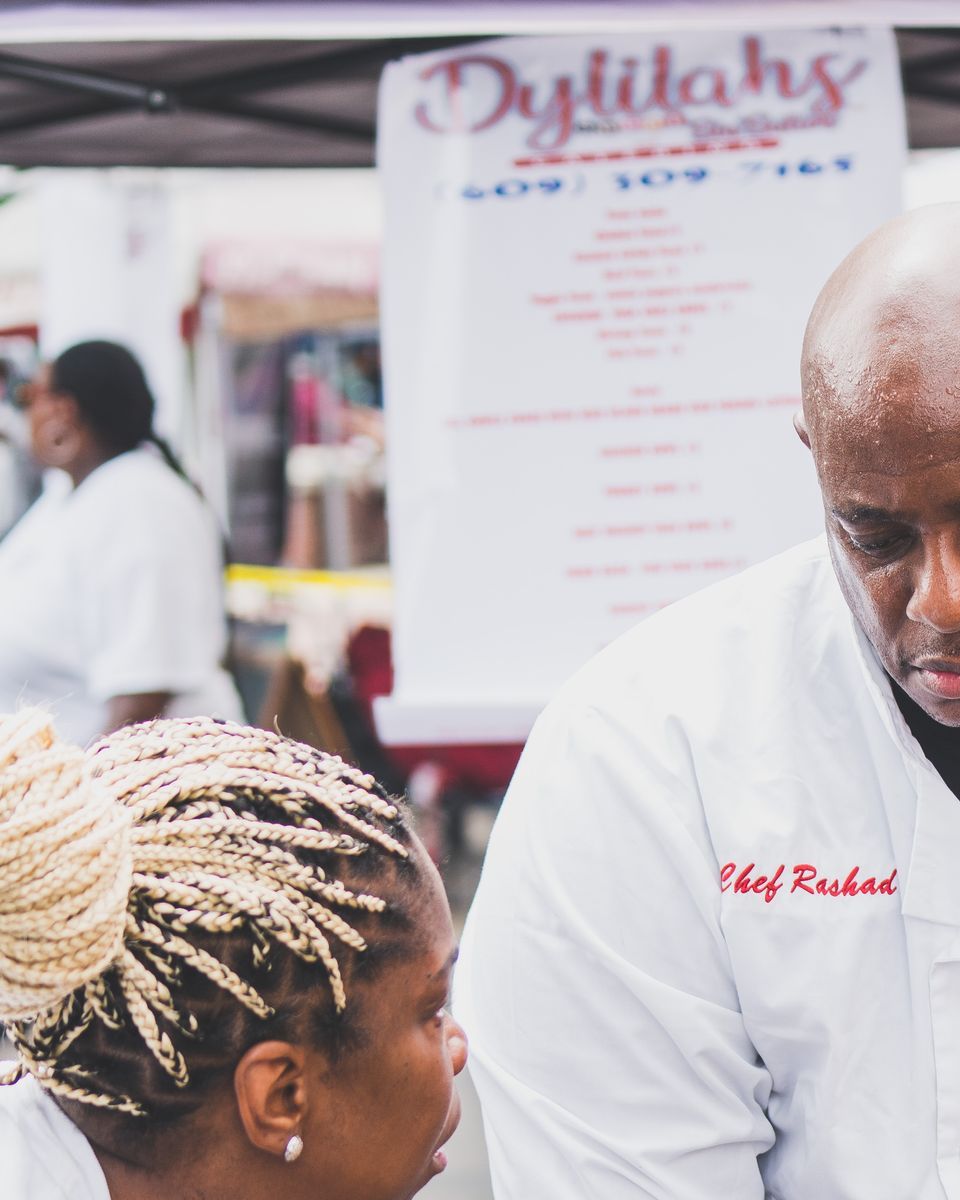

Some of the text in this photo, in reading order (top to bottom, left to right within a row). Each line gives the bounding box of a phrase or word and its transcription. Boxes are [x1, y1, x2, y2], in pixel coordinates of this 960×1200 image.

[412, 35, 871, 151] Dylilahs
[720, 862, 898, 903] Chef Rashad
